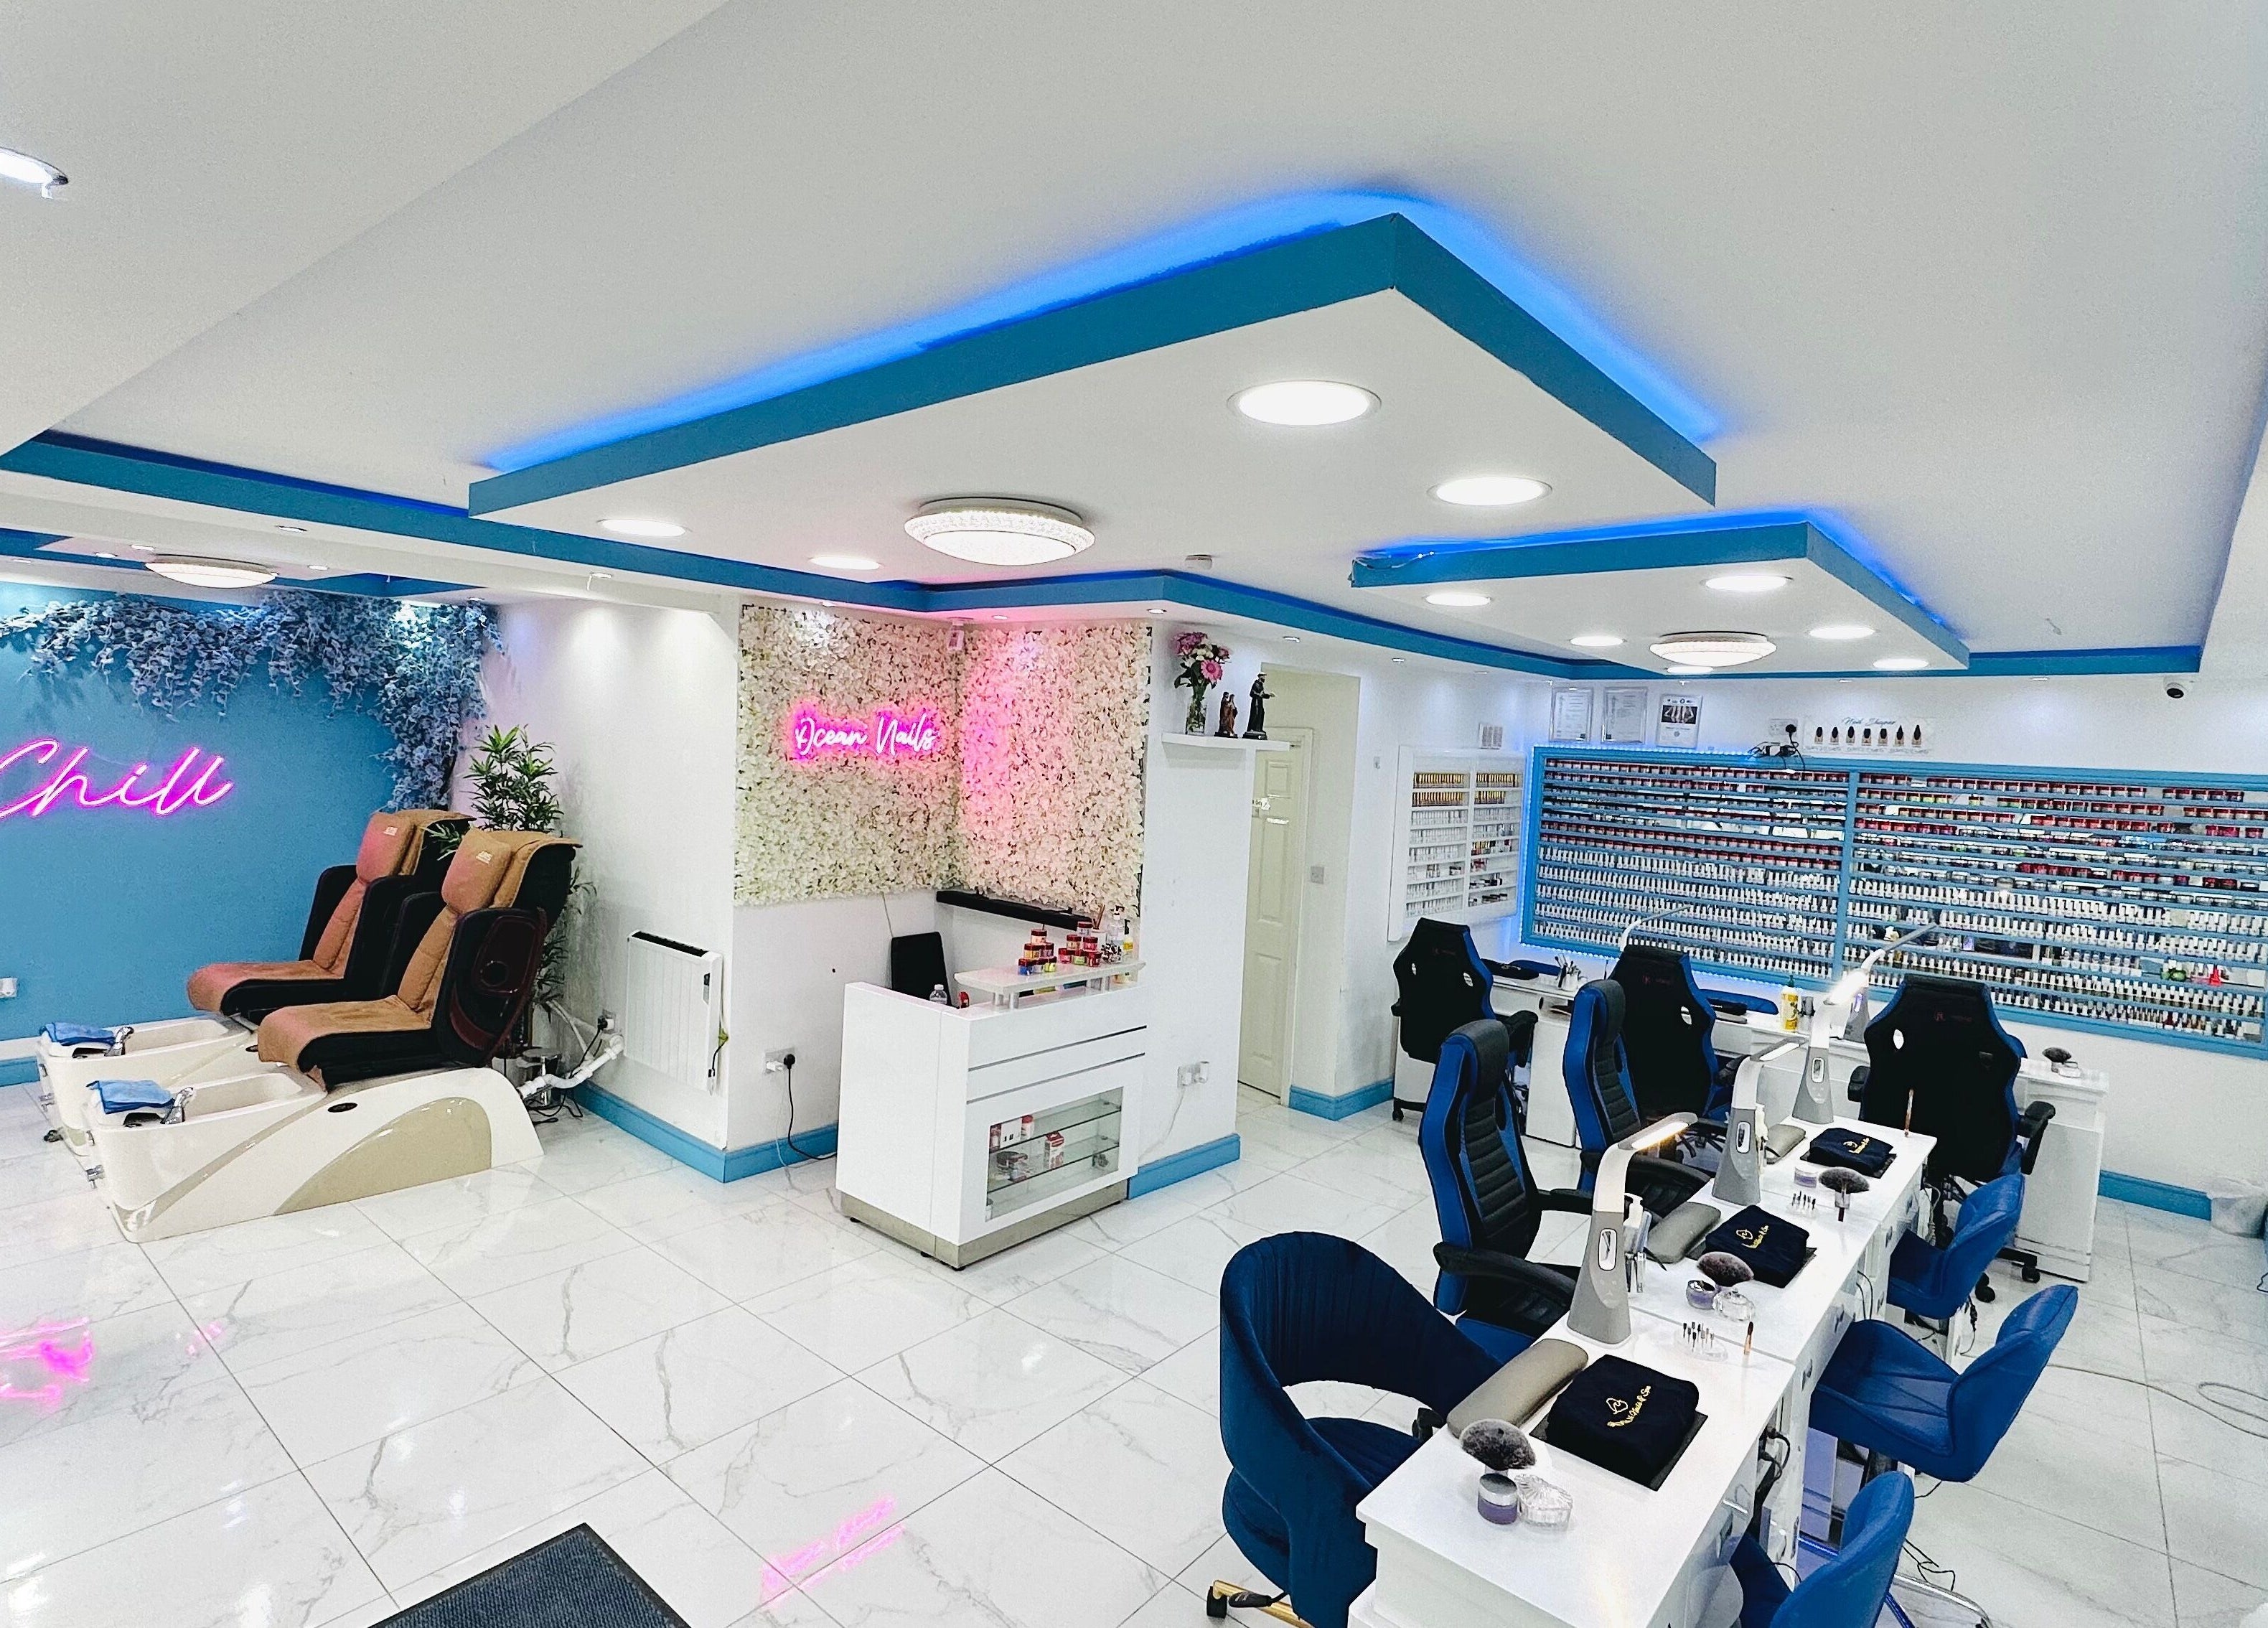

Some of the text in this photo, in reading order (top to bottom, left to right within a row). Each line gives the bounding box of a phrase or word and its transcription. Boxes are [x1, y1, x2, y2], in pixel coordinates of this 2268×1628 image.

[795, 713, 938, 755] Ocean Nails
[0, 739, 233, 818] Chill
